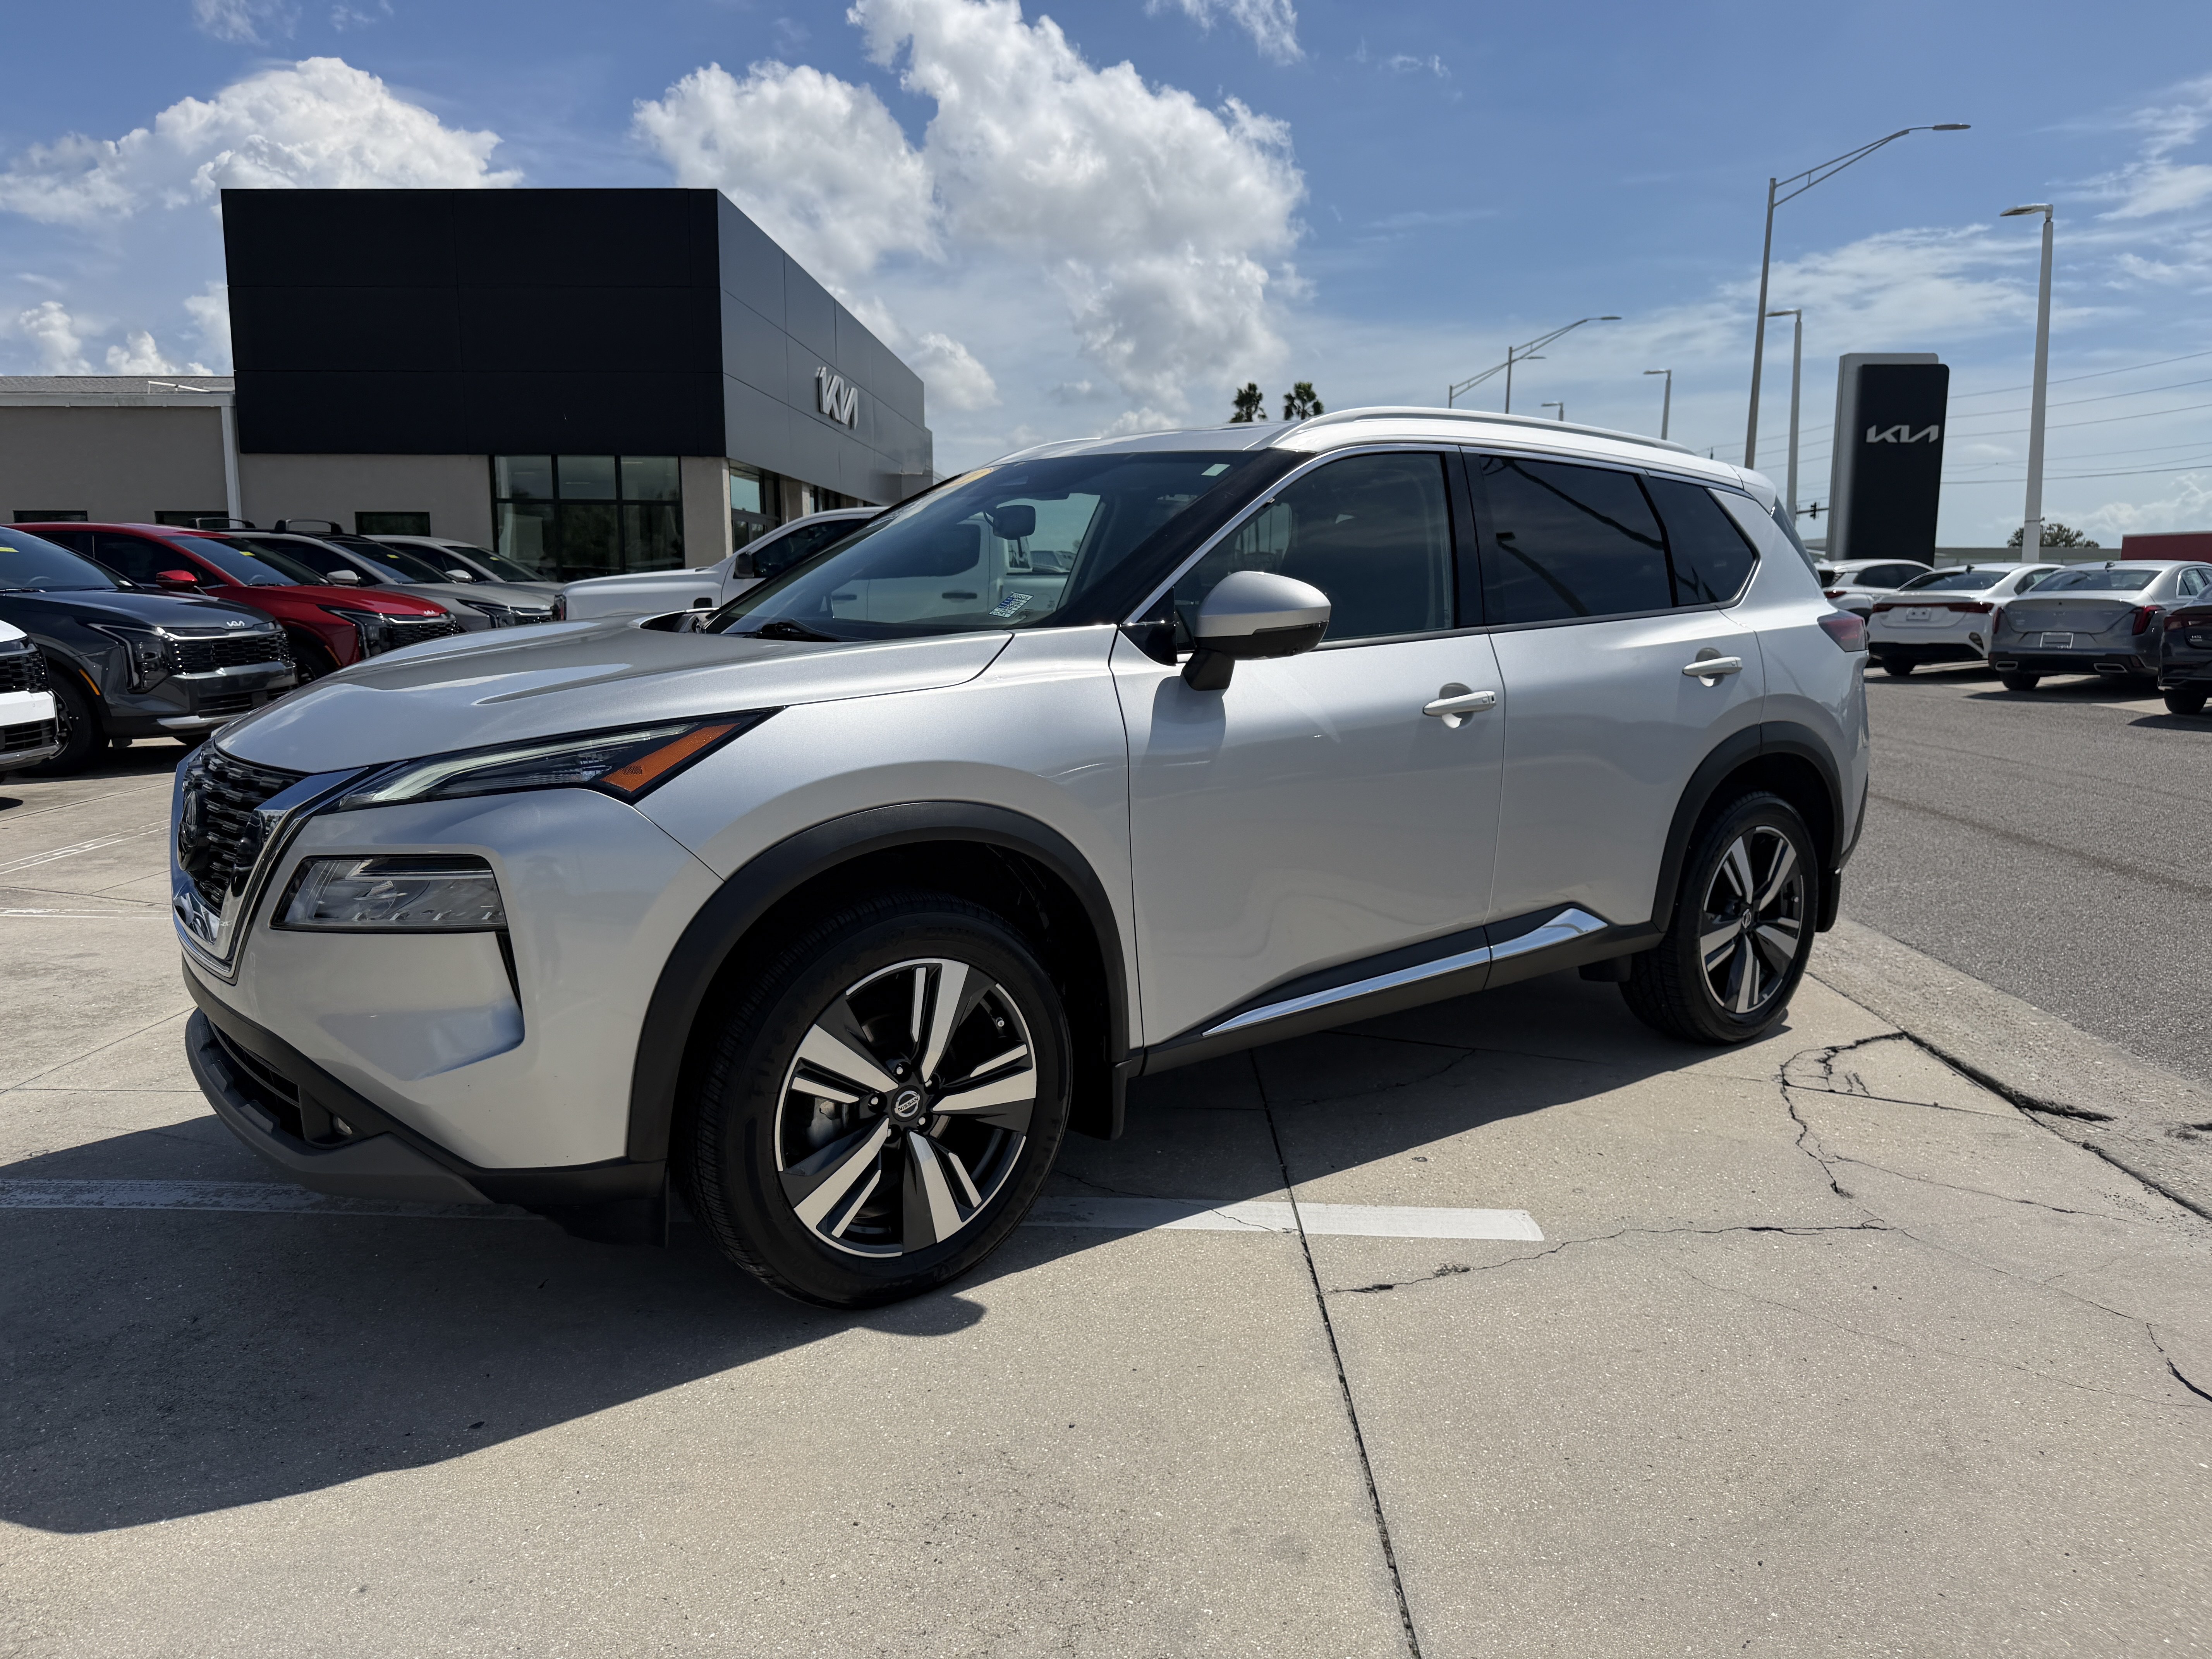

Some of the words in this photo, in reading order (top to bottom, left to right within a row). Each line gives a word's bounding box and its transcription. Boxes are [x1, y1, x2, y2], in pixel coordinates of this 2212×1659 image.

[816, 366, 858, 430] KIA
[1866, 424, 1939, 443] KIA
[898, 1097, 918, 1111] NISSAN
